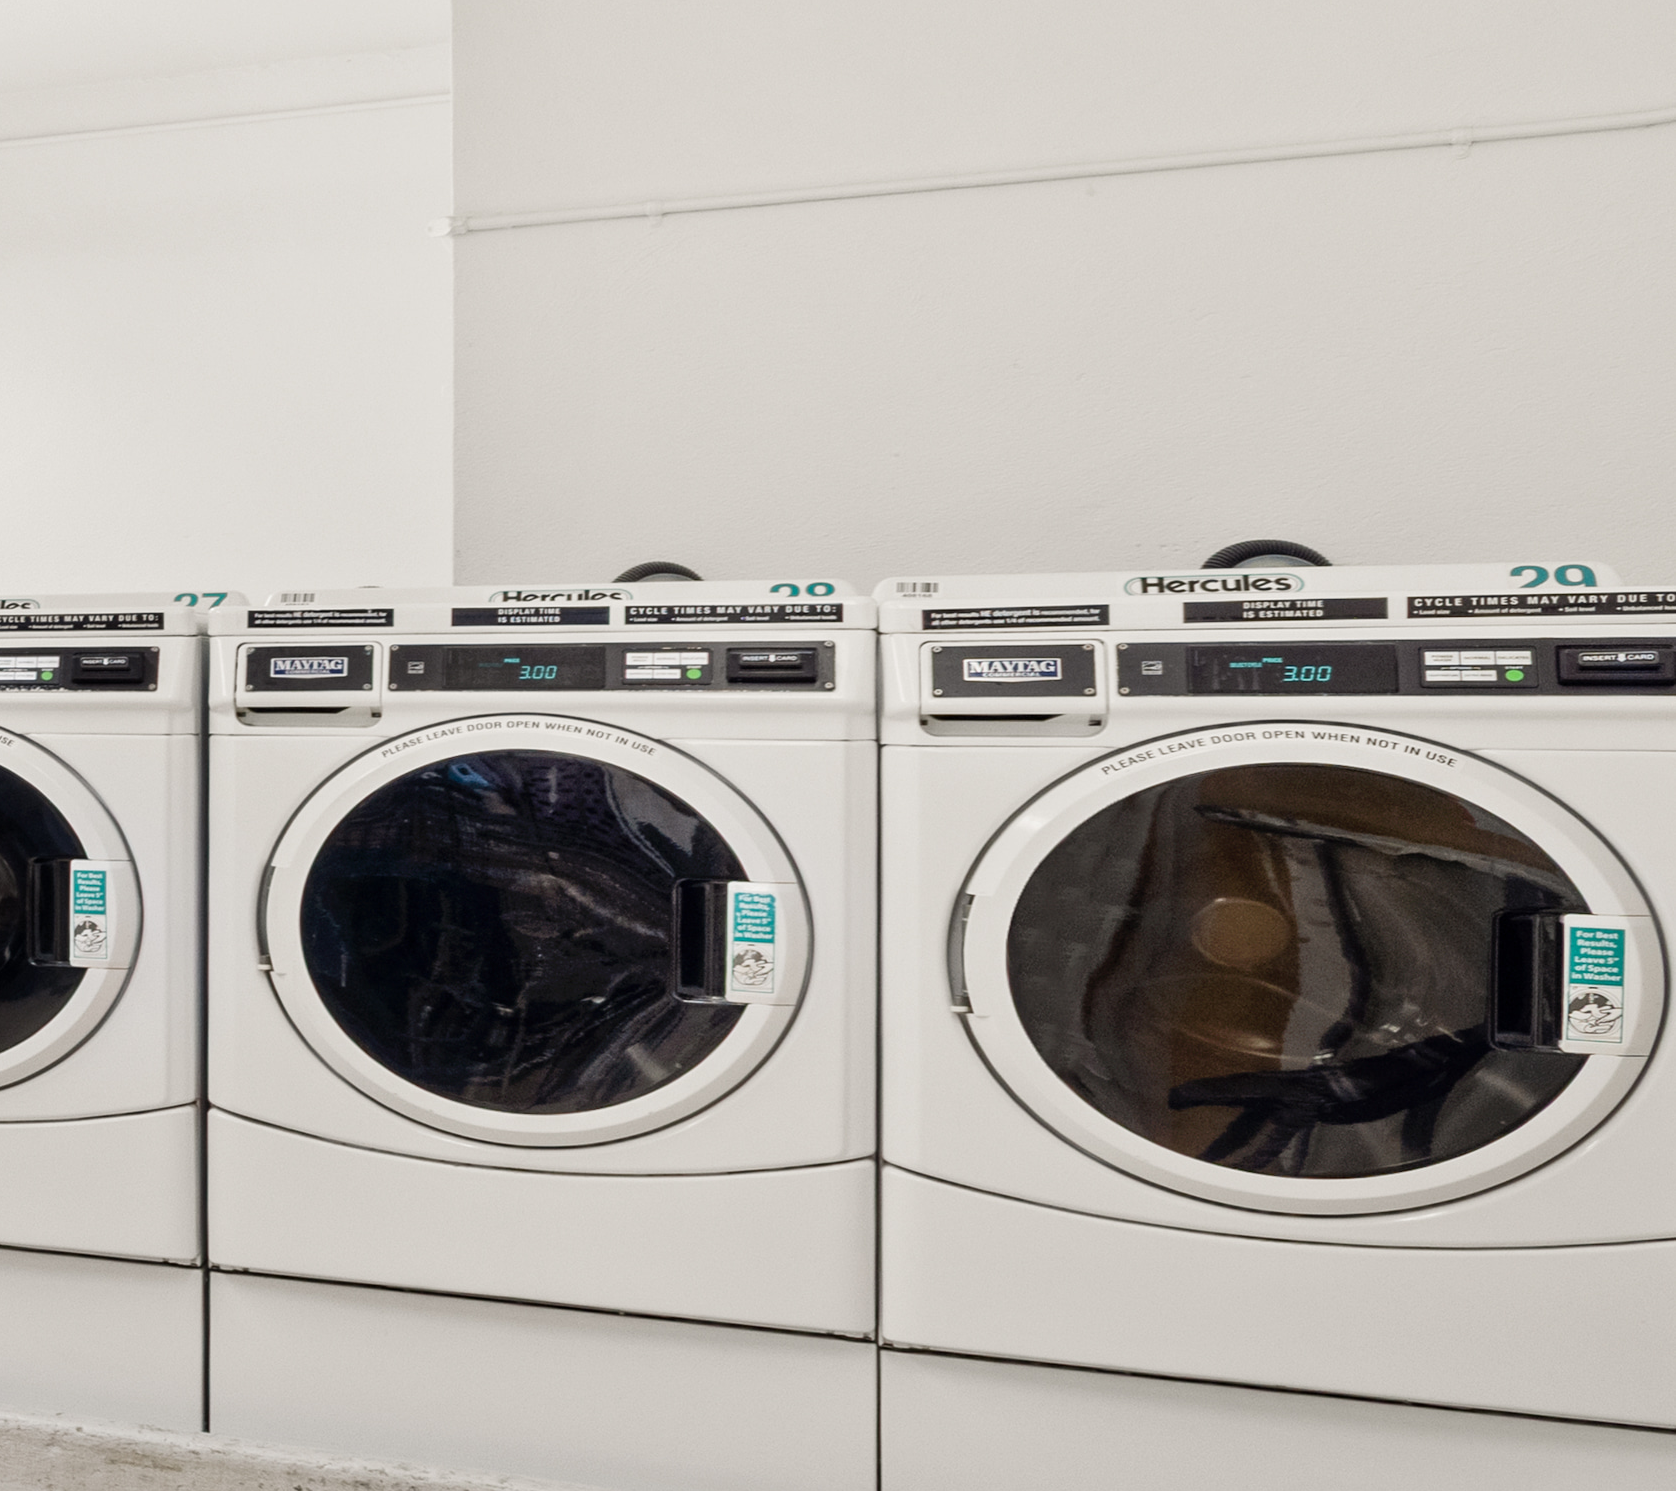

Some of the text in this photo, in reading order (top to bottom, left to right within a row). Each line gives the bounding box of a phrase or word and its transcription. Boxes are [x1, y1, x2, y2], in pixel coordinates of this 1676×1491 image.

[1140, 577, 1292, 594] Hercules
[1243, 600, 1324, 610] DISPLAY TIME
[1413, 597, 1464, 607] CYCLE
[1470, 596, 1519, 606] TIMES
[1526, 595, 1559, 605] MAY
[1567, 594, 1609, 604] VARY
[1617, 593, 1646, 603] DUE
[1243, 609, 1324, 618] IS ESTIMATED
[1582, 652, 1655, 663] INSERT CARD
[274, 659, 345, 671] MAYTAG
[970, 660, 1057, 673] MAYTAG
[519, 665, 558, 680] 3.00
[1283, 665, 1332, 683] 3.00
[1101, 730, 1459, 776] PLEASE LEAVE DOOR OPEN WHEN NOT IN USE
